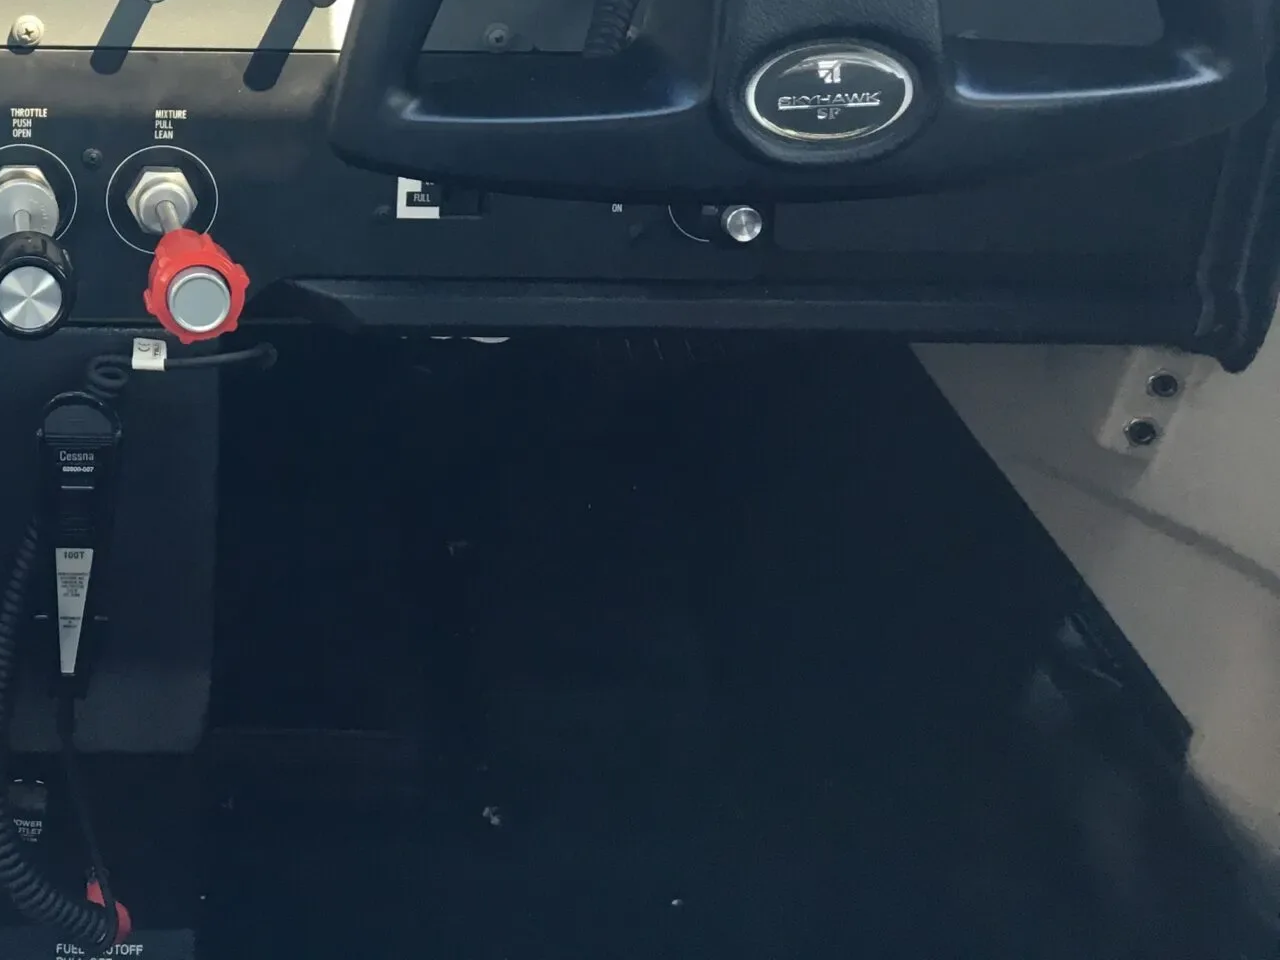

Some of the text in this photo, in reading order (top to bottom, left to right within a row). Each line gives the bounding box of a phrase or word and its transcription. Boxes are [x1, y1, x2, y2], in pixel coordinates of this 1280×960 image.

[778, 91, 882, 110] SKYHAWK
[10, 108, 47, 118] THROTTLE
[155, 110, 187, 120] MIXTURE
[12, 118, 32, 128] PUSH
[155, 120, 173, 130] PULL
[12, 129, 32, 138] OPEN
[154, 130, 173, 139] LEAN
[60, 450, 94, 461] Cessna
